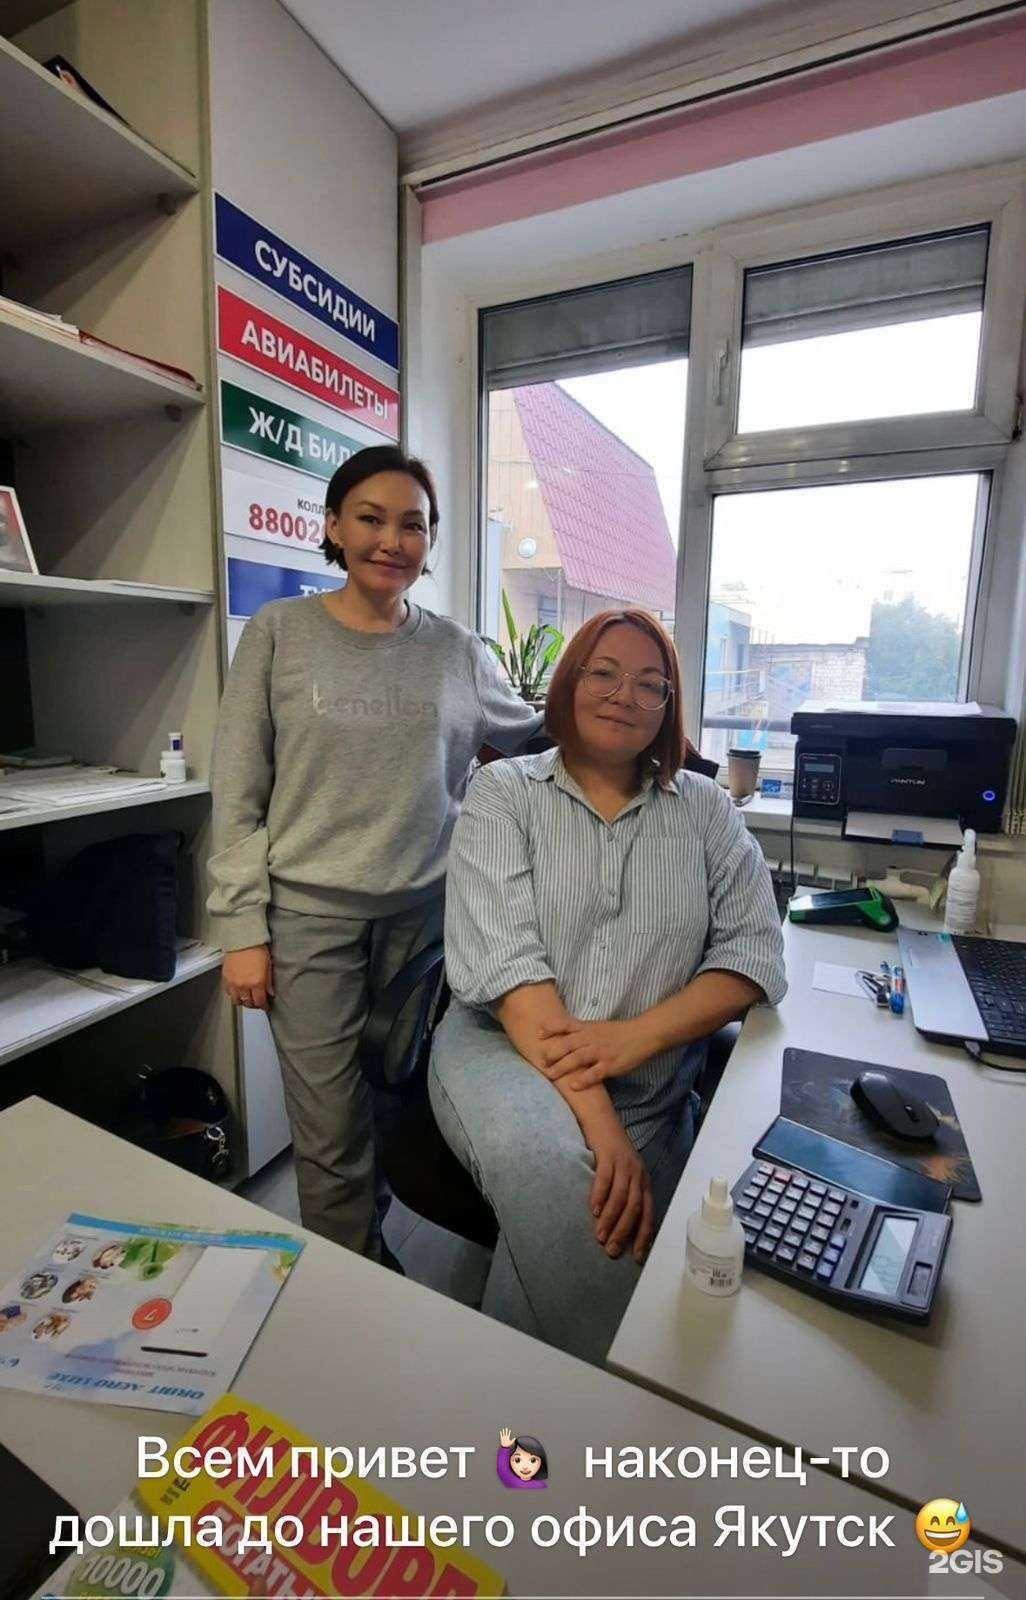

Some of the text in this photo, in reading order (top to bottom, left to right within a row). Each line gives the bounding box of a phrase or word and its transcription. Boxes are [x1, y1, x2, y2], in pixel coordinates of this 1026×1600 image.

[254, 240, 376, 342] СУБСИДИИ
[241, 320, 389, 419] АВИАБИЛЕТЫ
[248, 406, 354, 467] Ж/Д БИЛ
[249, 503, 325, 544] 88002
[79, 1554, 166, 1597] 10000
